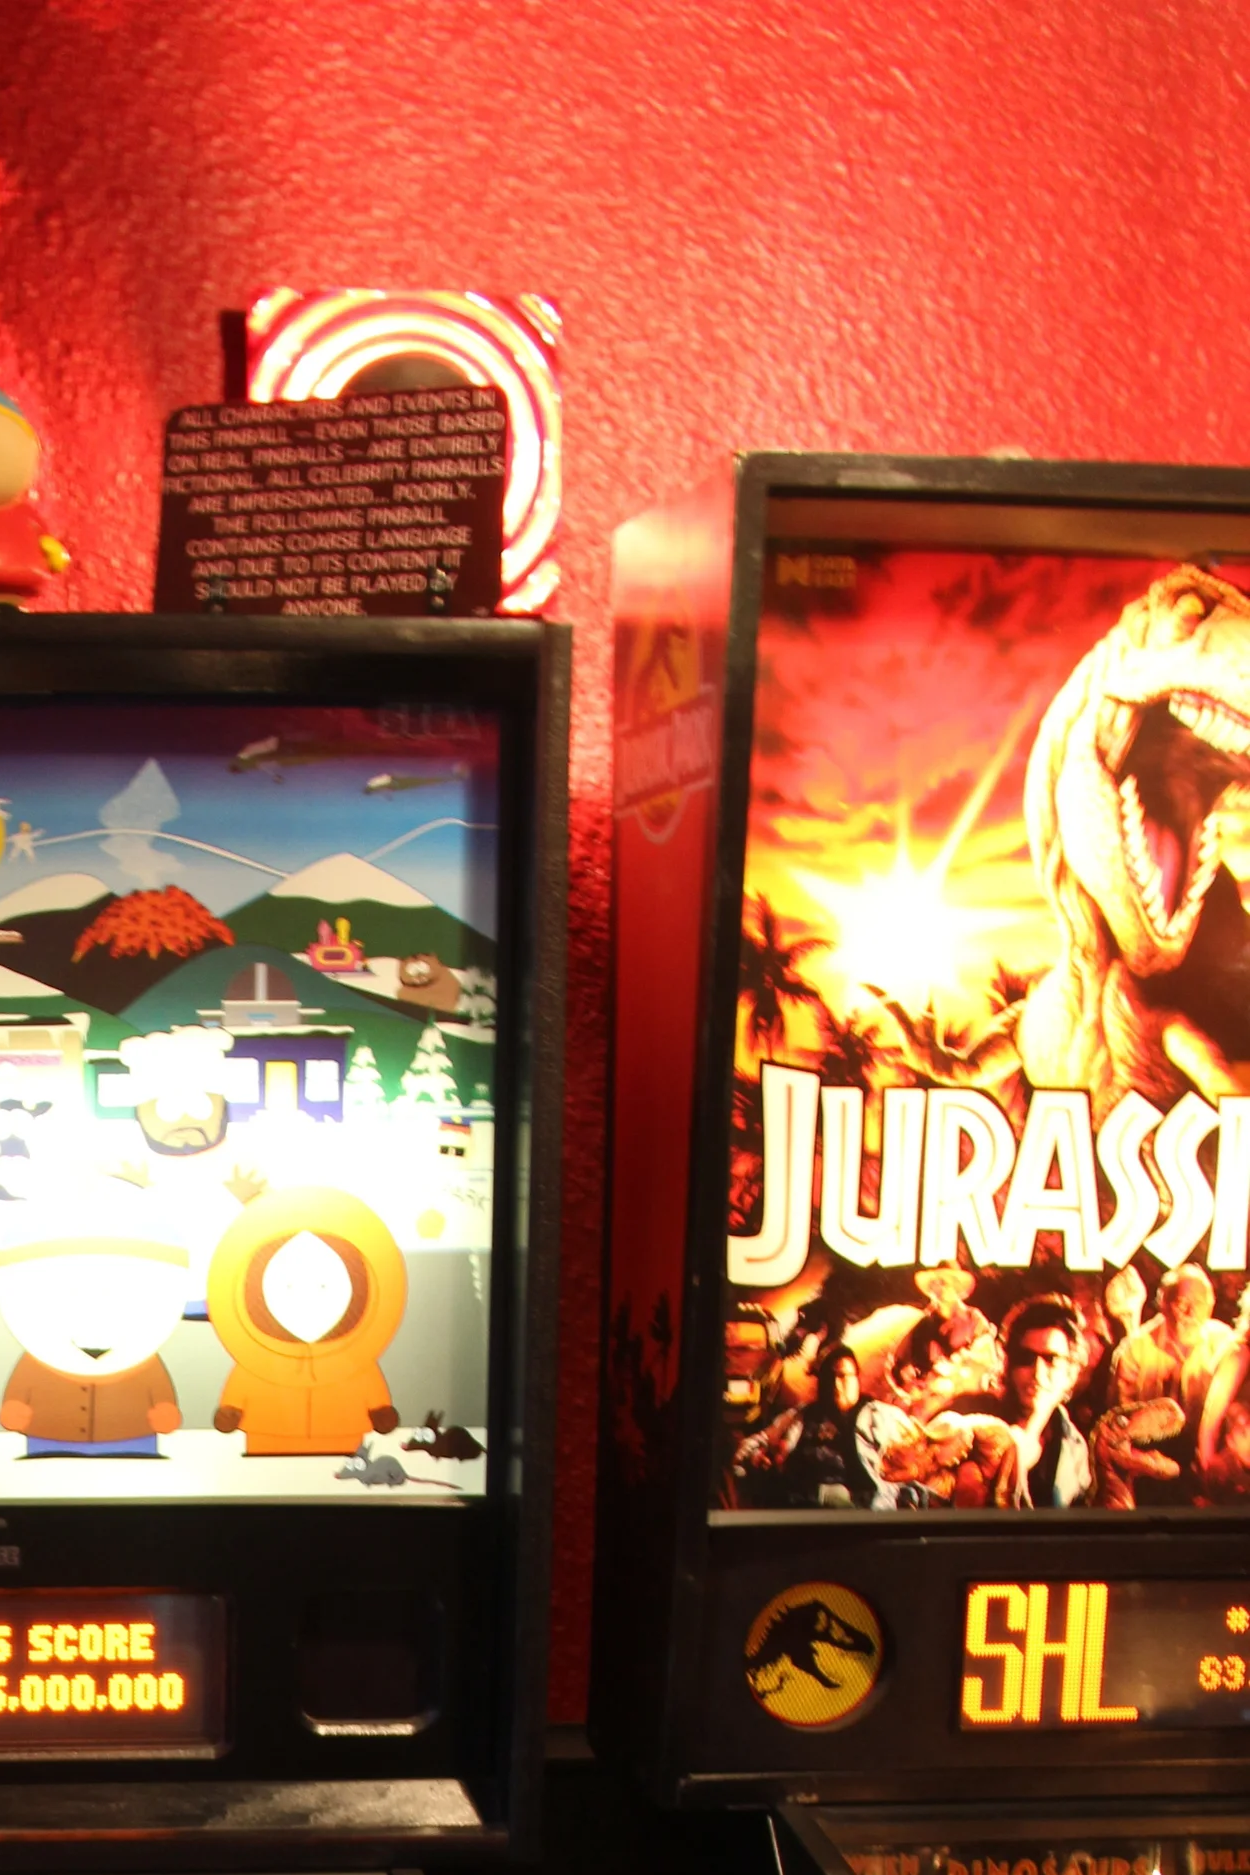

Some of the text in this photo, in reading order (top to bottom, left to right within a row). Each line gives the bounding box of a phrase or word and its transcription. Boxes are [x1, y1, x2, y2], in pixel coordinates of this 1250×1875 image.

[178, 389, 495, 427] ALL CHARACTERS AND EVENTS IN
[168, 410, 506, 449] THIS PINBALL EVEN THOSE BASED
[167, 433, 501, 473] ON REAL PINBALLS ARE ENTIRELY
[265, 469, 304, 488] ALL
[307, 462, 409, 487] CELEBRITY
[411, 456, 506, 480] PINBALLS
[187, 495, 226, 514] ARE
[212, 505, 449, 534] THE FOLLOWING PINBALL
[185, 525, 473, 558] CONTAINS COARSE LANGUAGE
[191, 548, 465, 578] AND DUE TO ITS CONTENT IT
[194, 579, 273, 600] SOULD
[275, 577, 318, 597] NOT
[320, 575, 348, 596] BE
[350, 573, 428, 594] PLAYED
[727, 1061, 1250, 1287] JURASSI
[27, 1622, 156, 1663] SCORE
[962, 1583, 1139, 1723] SHL
